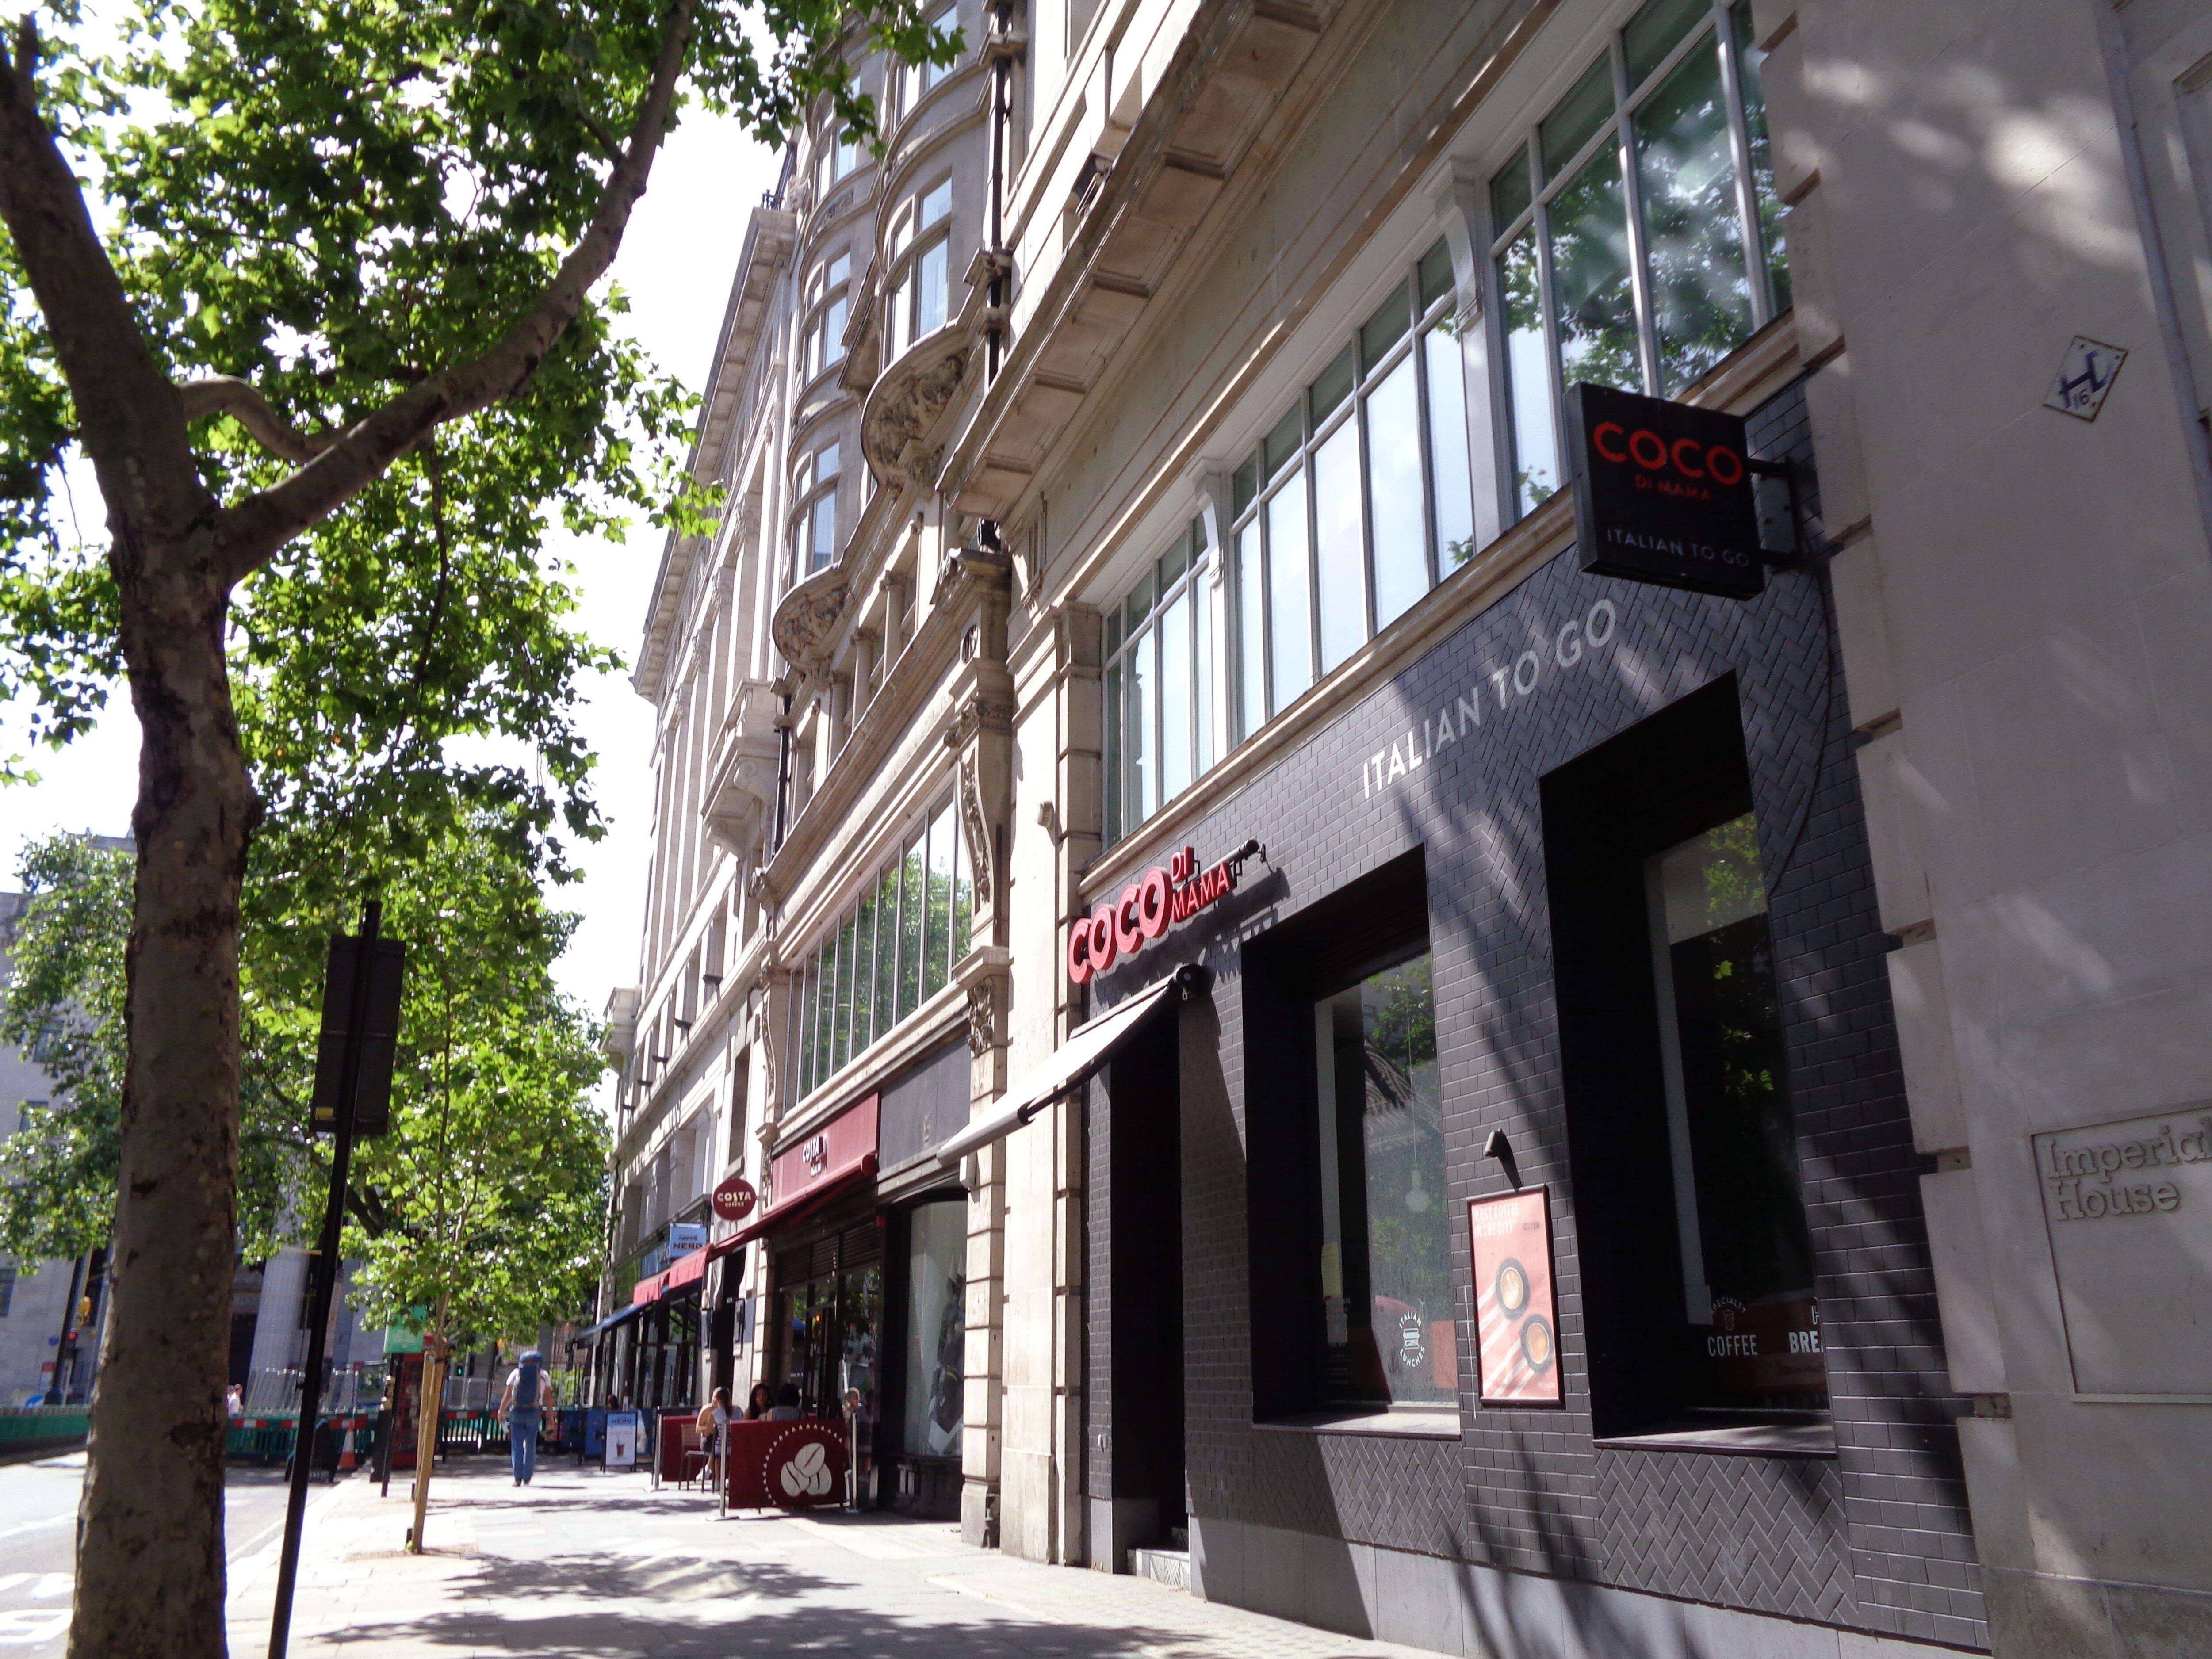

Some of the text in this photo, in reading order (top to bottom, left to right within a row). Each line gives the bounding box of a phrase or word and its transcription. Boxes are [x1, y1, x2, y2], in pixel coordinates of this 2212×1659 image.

[1592, 421, 1744, 486] COCO
[1634, 474, 1712, 501] DI MAMA
[1607, 528, 1750, 567] ITALIAN TO GO
[1362, 599, 1616, 800] ITALIAN TO GO
[1171, 861, 1234, 923] MAMA
[1068, 845, 1195, 984] COCO DI
[802, 1135, 820, 1163] COSTA
[717, 1191, 752, 1202] COSTA
[2049, 1178, 2181, 1222] House
[1493, 1202, 1519, 1219] COFFEE
[1474, 1224, 1482, 1238] IN
[1482, 1222, 1496, 1237] THE
[1399, 1310, 1422, 1329] ITALIAN
[1707, 1334, 1758, 1357] COFFEE
[1788, 1330, 1824, 1353] BRE
[1400, 1345, 1426, 1367] LUNCHES
